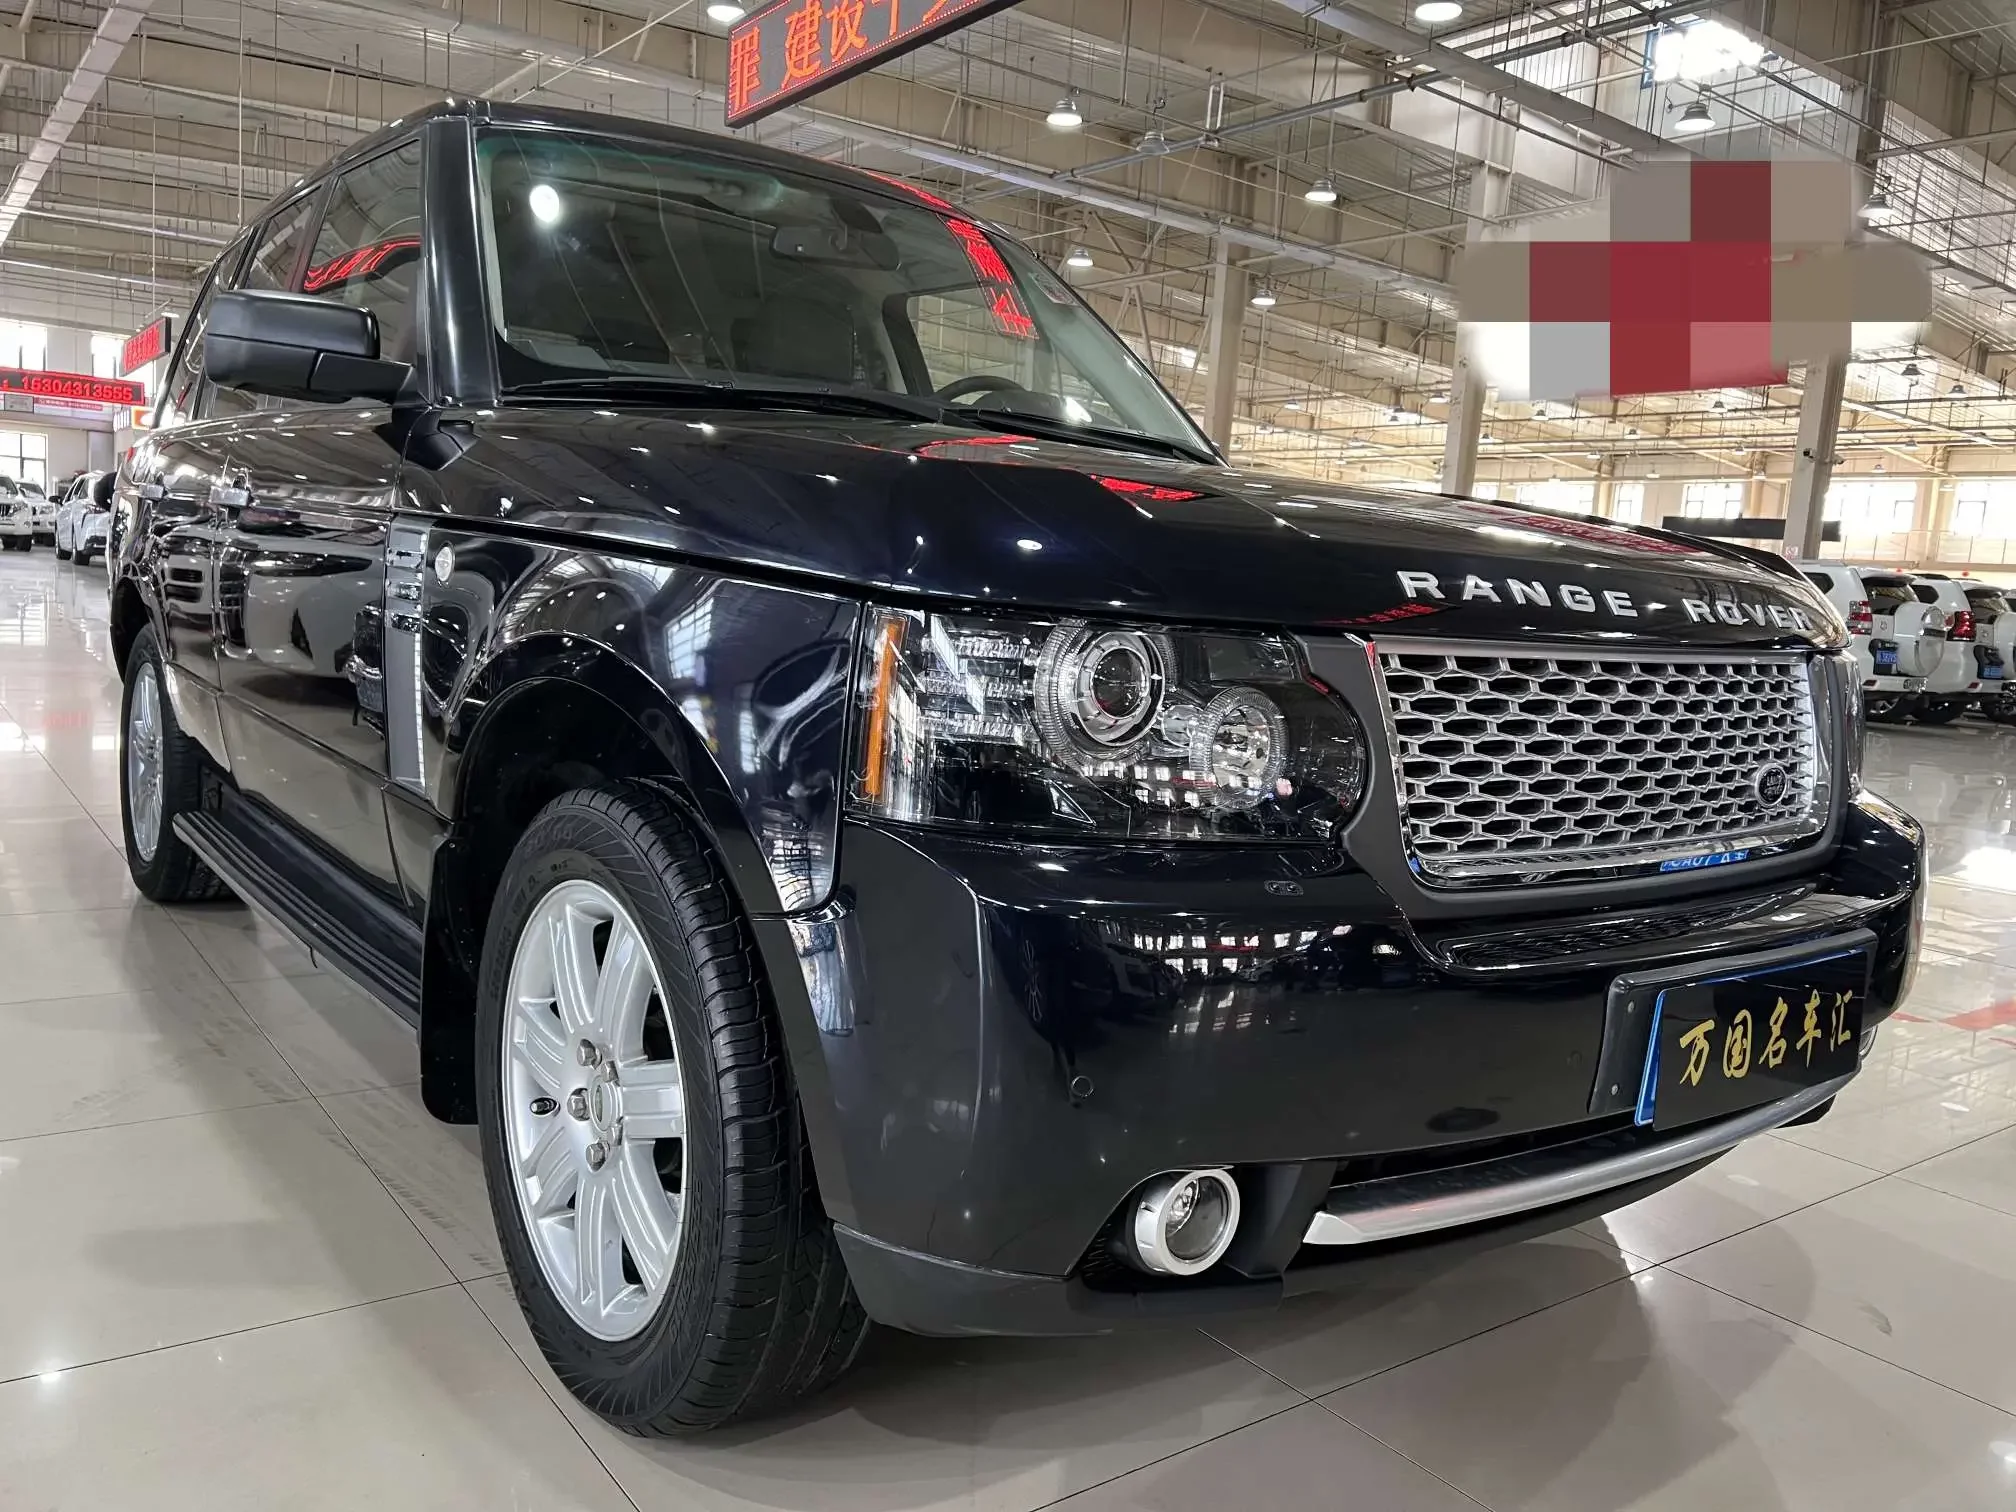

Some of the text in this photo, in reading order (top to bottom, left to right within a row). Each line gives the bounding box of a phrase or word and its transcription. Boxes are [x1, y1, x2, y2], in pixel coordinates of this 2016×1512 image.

[1396, 570, 1639, 617] RANGE
[1681, 597, 1813, 633] ROVER
[1679, 988, 1853, 1087] 万国名车汇
